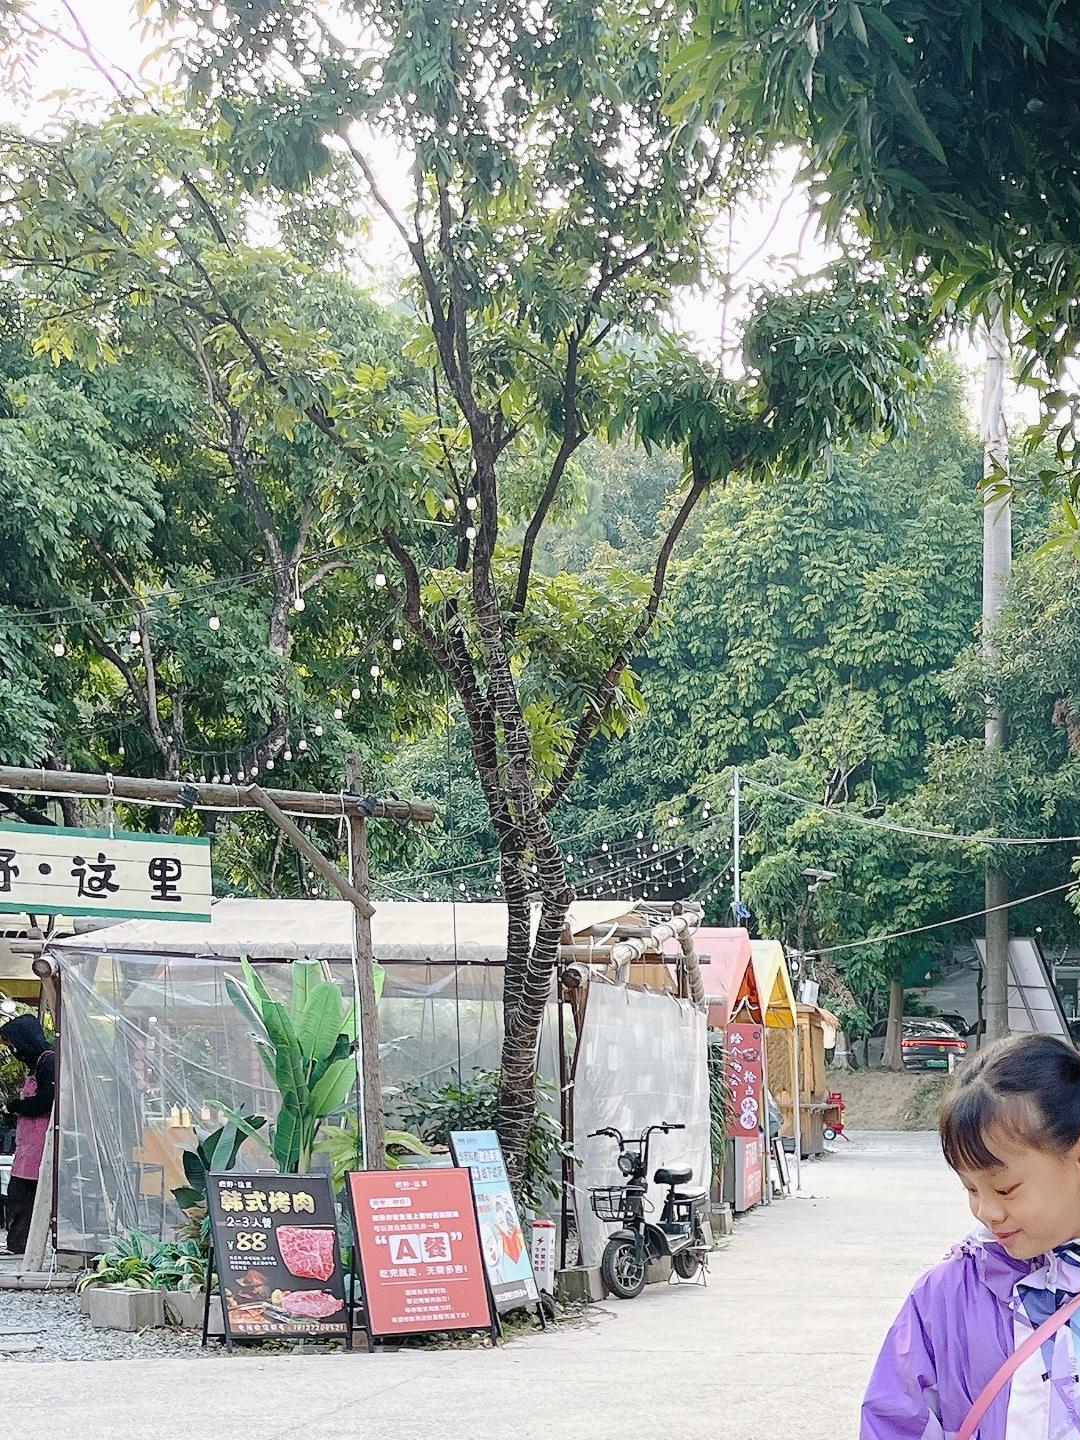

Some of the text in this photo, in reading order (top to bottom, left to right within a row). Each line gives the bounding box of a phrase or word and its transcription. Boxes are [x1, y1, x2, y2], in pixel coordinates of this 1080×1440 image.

[220, 1190, 315, 1214] 韩式烤肉
[226, 1217, 273, 1229] 2-3人餐
